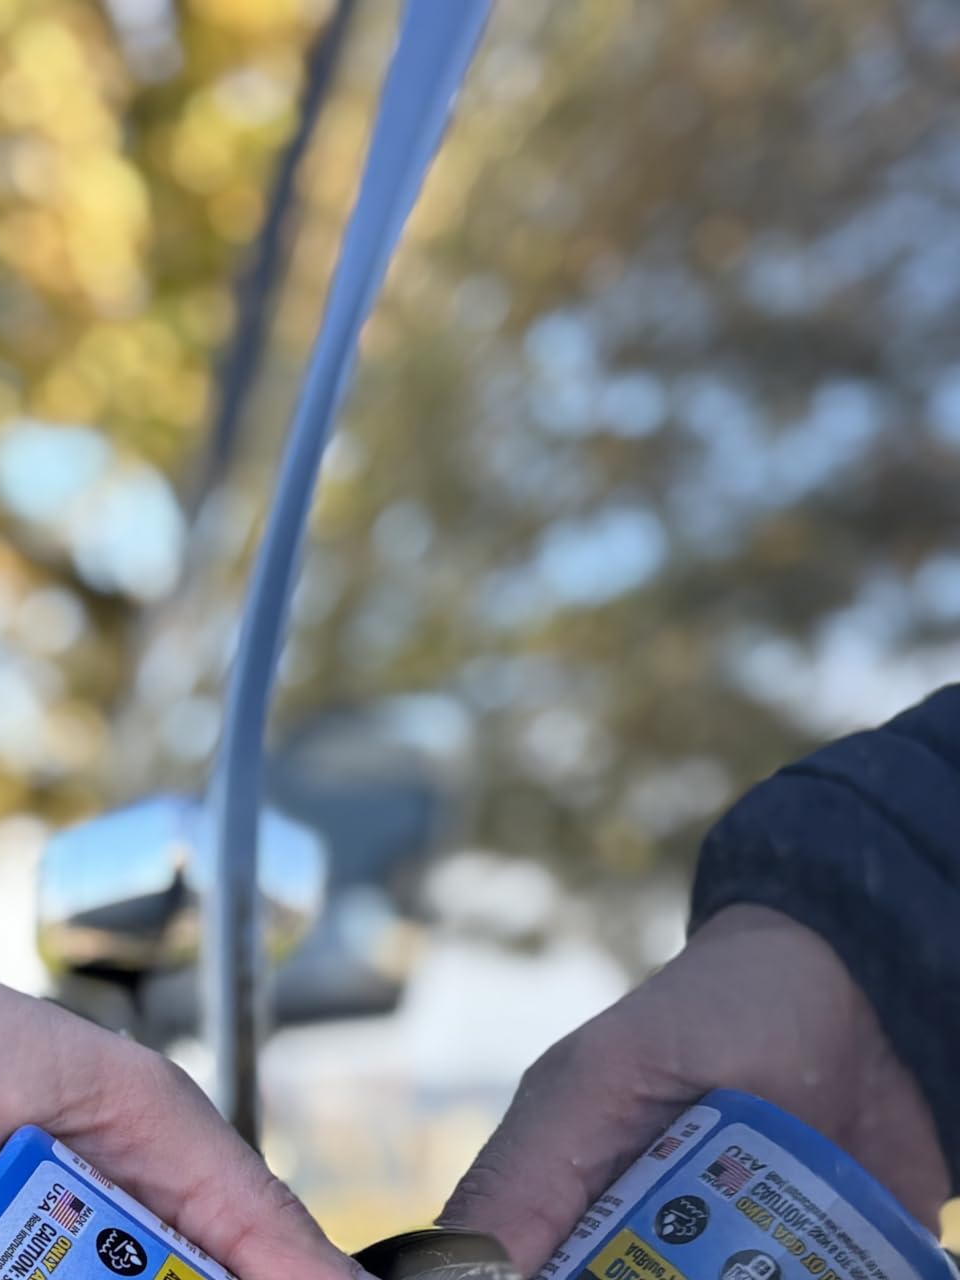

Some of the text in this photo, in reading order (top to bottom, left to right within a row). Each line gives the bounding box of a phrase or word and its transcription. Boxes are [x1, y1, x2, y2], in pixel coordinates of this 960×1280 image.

[36, 1181, 65, 1213] USA
[22, 1212, 42, 1232] Read
[68, 1205, 93, 1236] MADE IN
[6, 1221, 59, 1280] CAUTION:
[37, 1233, 74, 1274] ONLY
